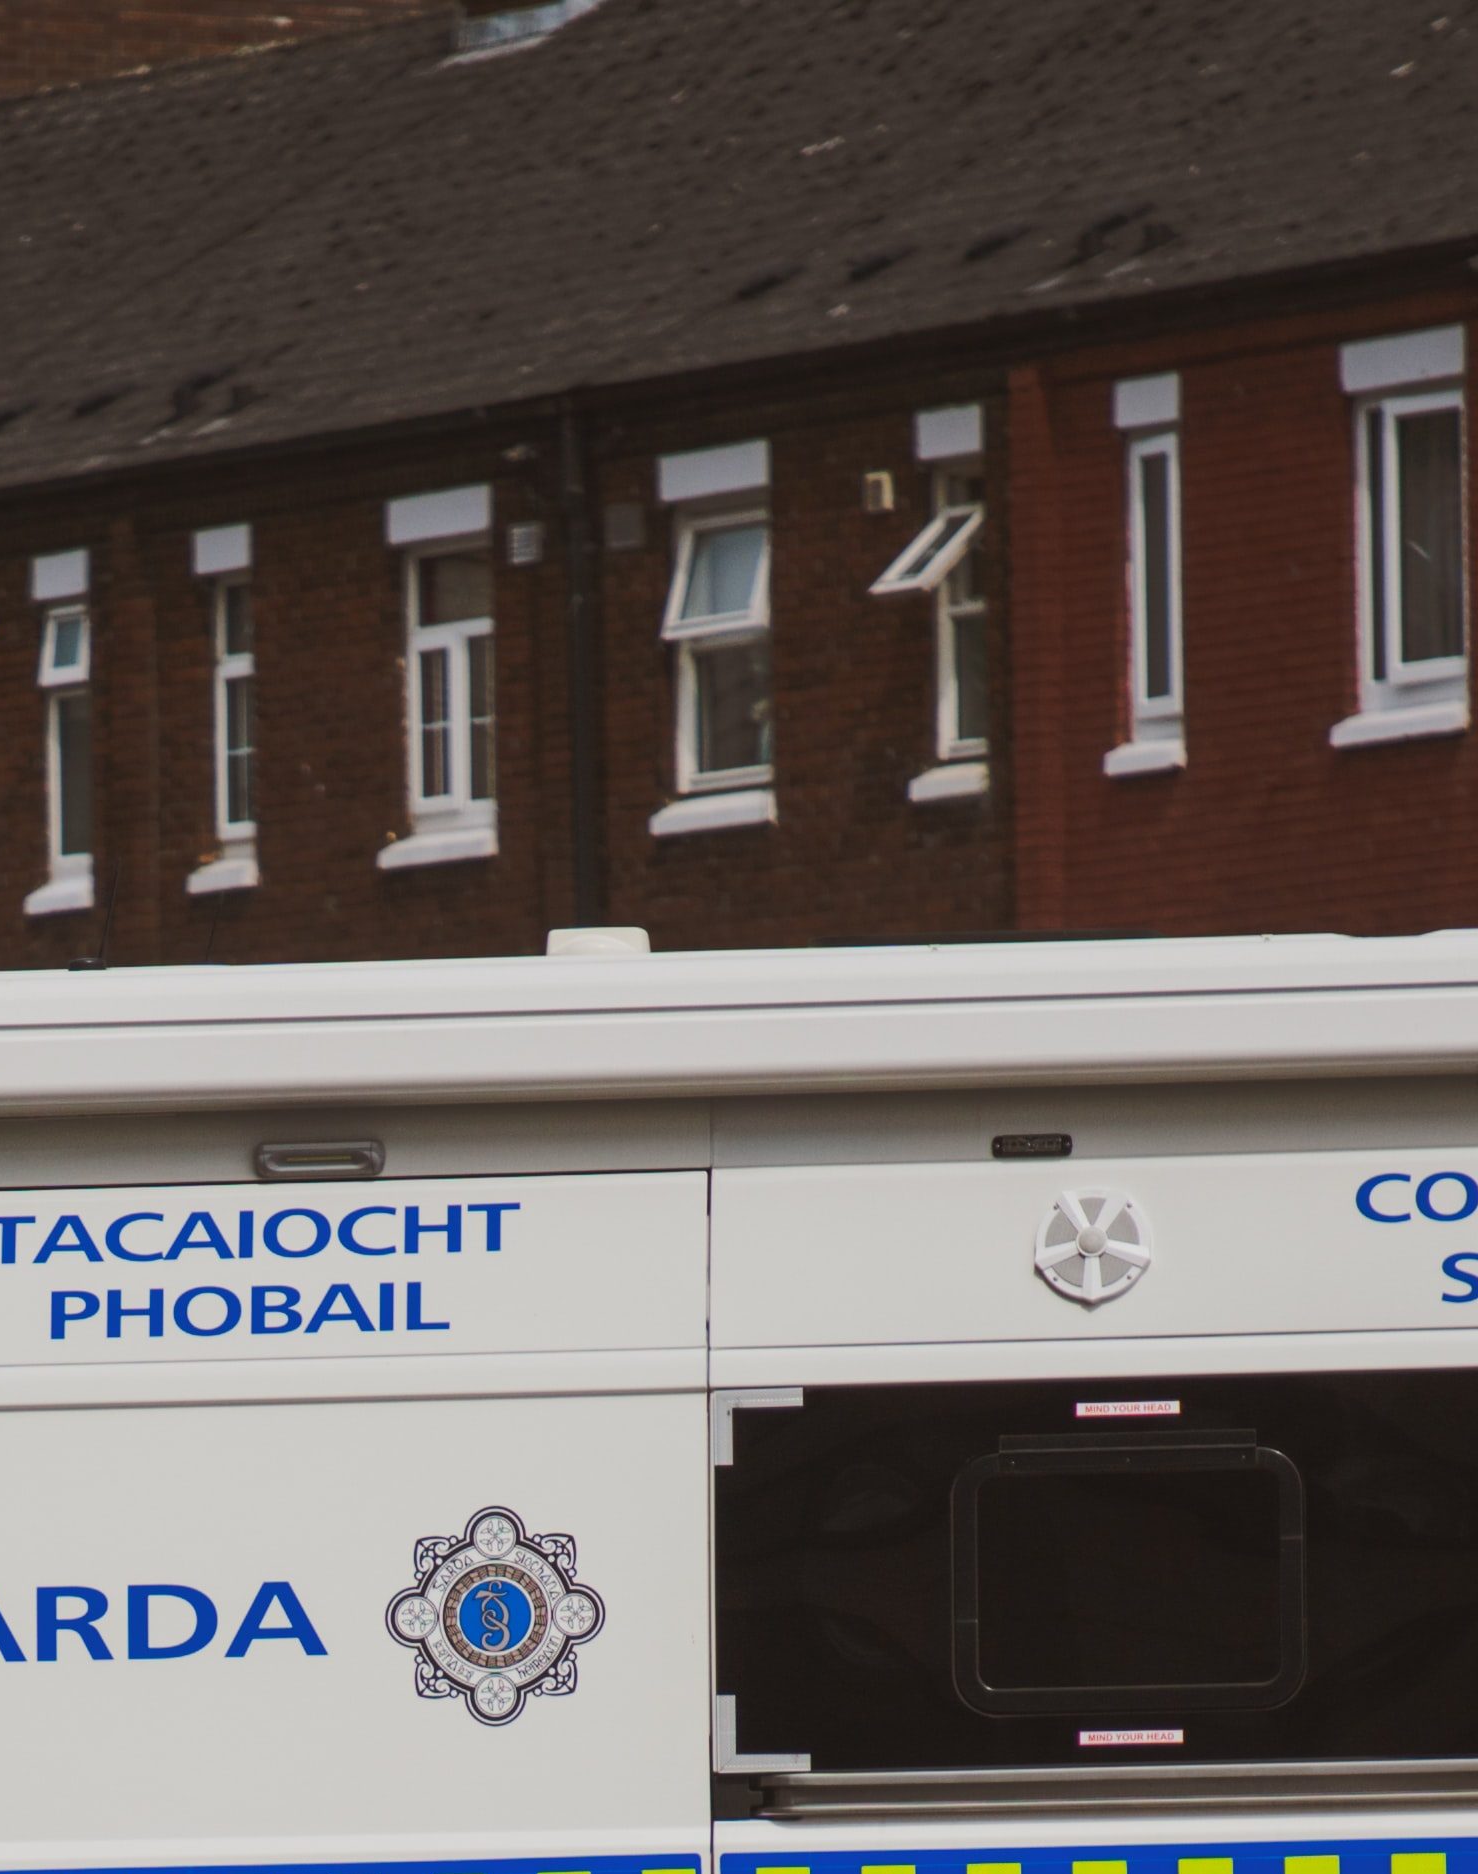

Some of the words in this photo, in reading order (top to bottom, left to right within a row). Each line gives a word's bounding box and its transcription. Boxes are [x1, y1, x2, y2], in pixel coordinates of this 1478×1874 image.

[49, 1281, 450, 1341] PHOBAIL
[1085, 1404, 1110, 1413] MIND
[1113, 1404, 1141, 1413] YOUR
[1144, 1403, 1171, 1412] HEAD
[1088, 1734, 1113, 1742] MIND
[1116, 1733, 1143, 1742] YOUR
[1146, 1732, 1174, 1741] HEAD
